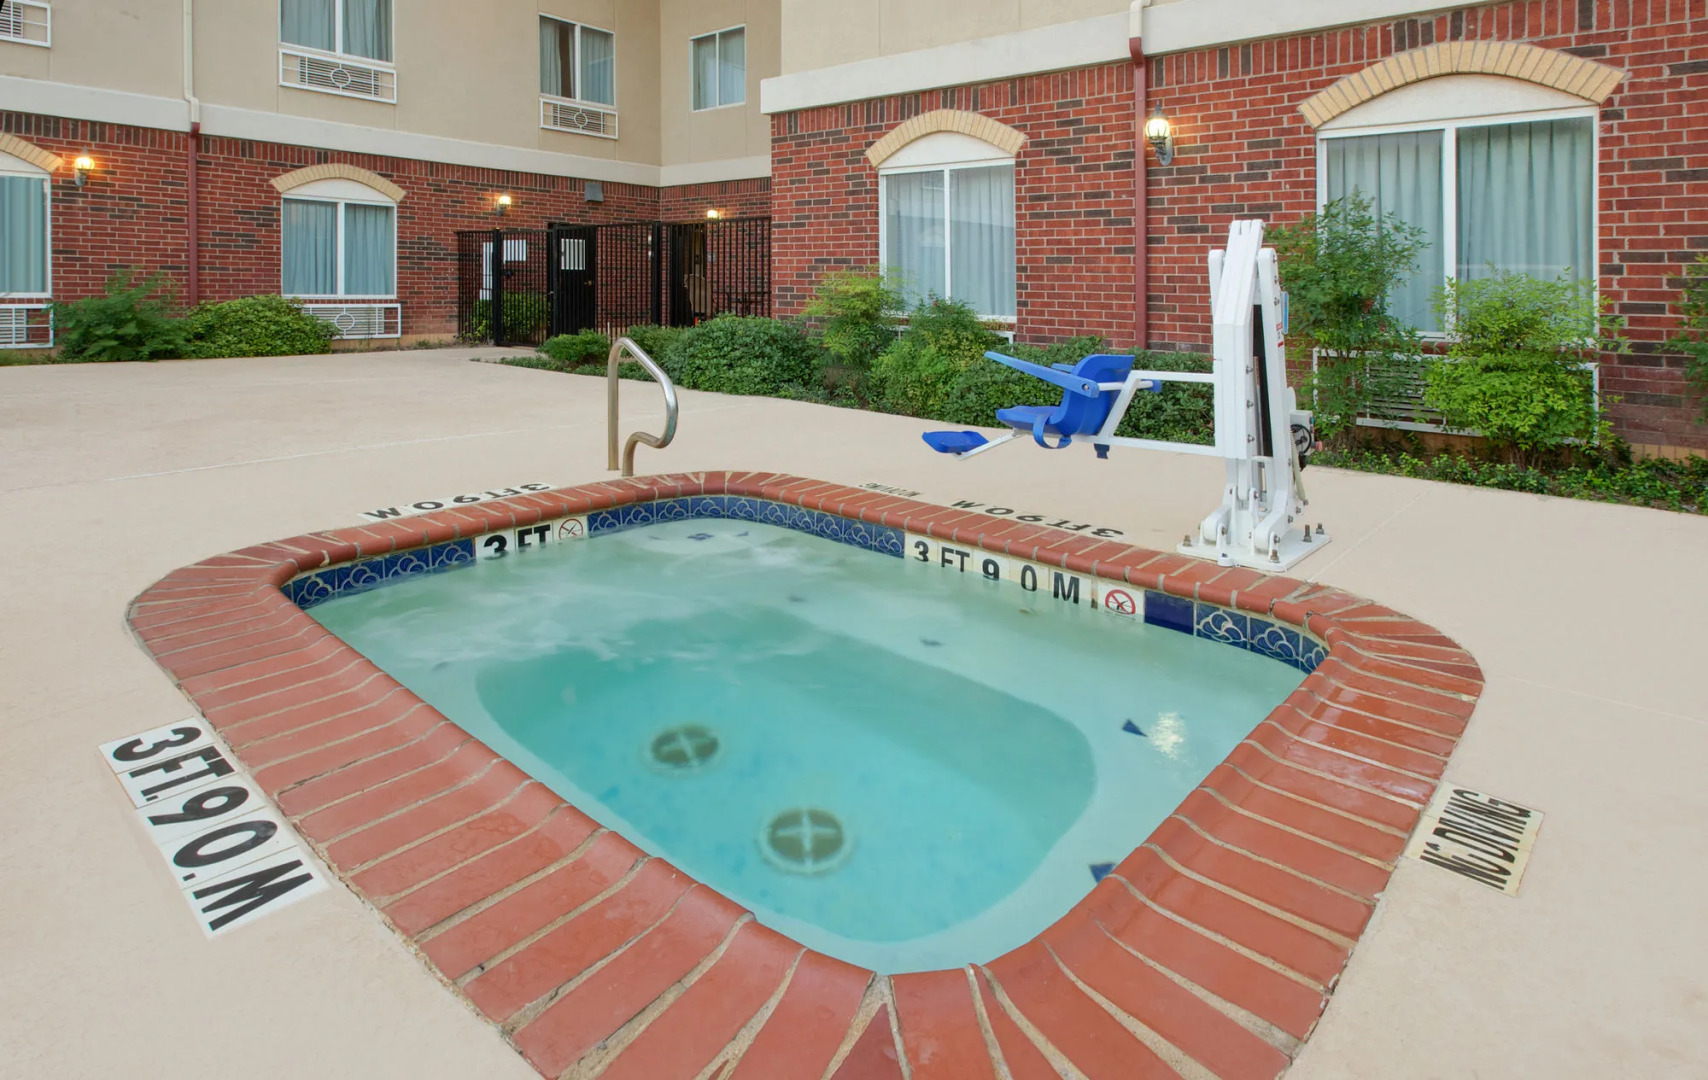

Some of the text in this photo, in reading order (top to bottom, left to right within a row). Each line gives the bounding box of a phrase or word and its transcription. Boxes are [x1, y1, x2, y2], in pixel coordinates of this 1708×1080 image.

[1053, 571, 1080, 604] M
[1432, 789, 1531, 864] DIVING
[192, 859, 314, 932] M
